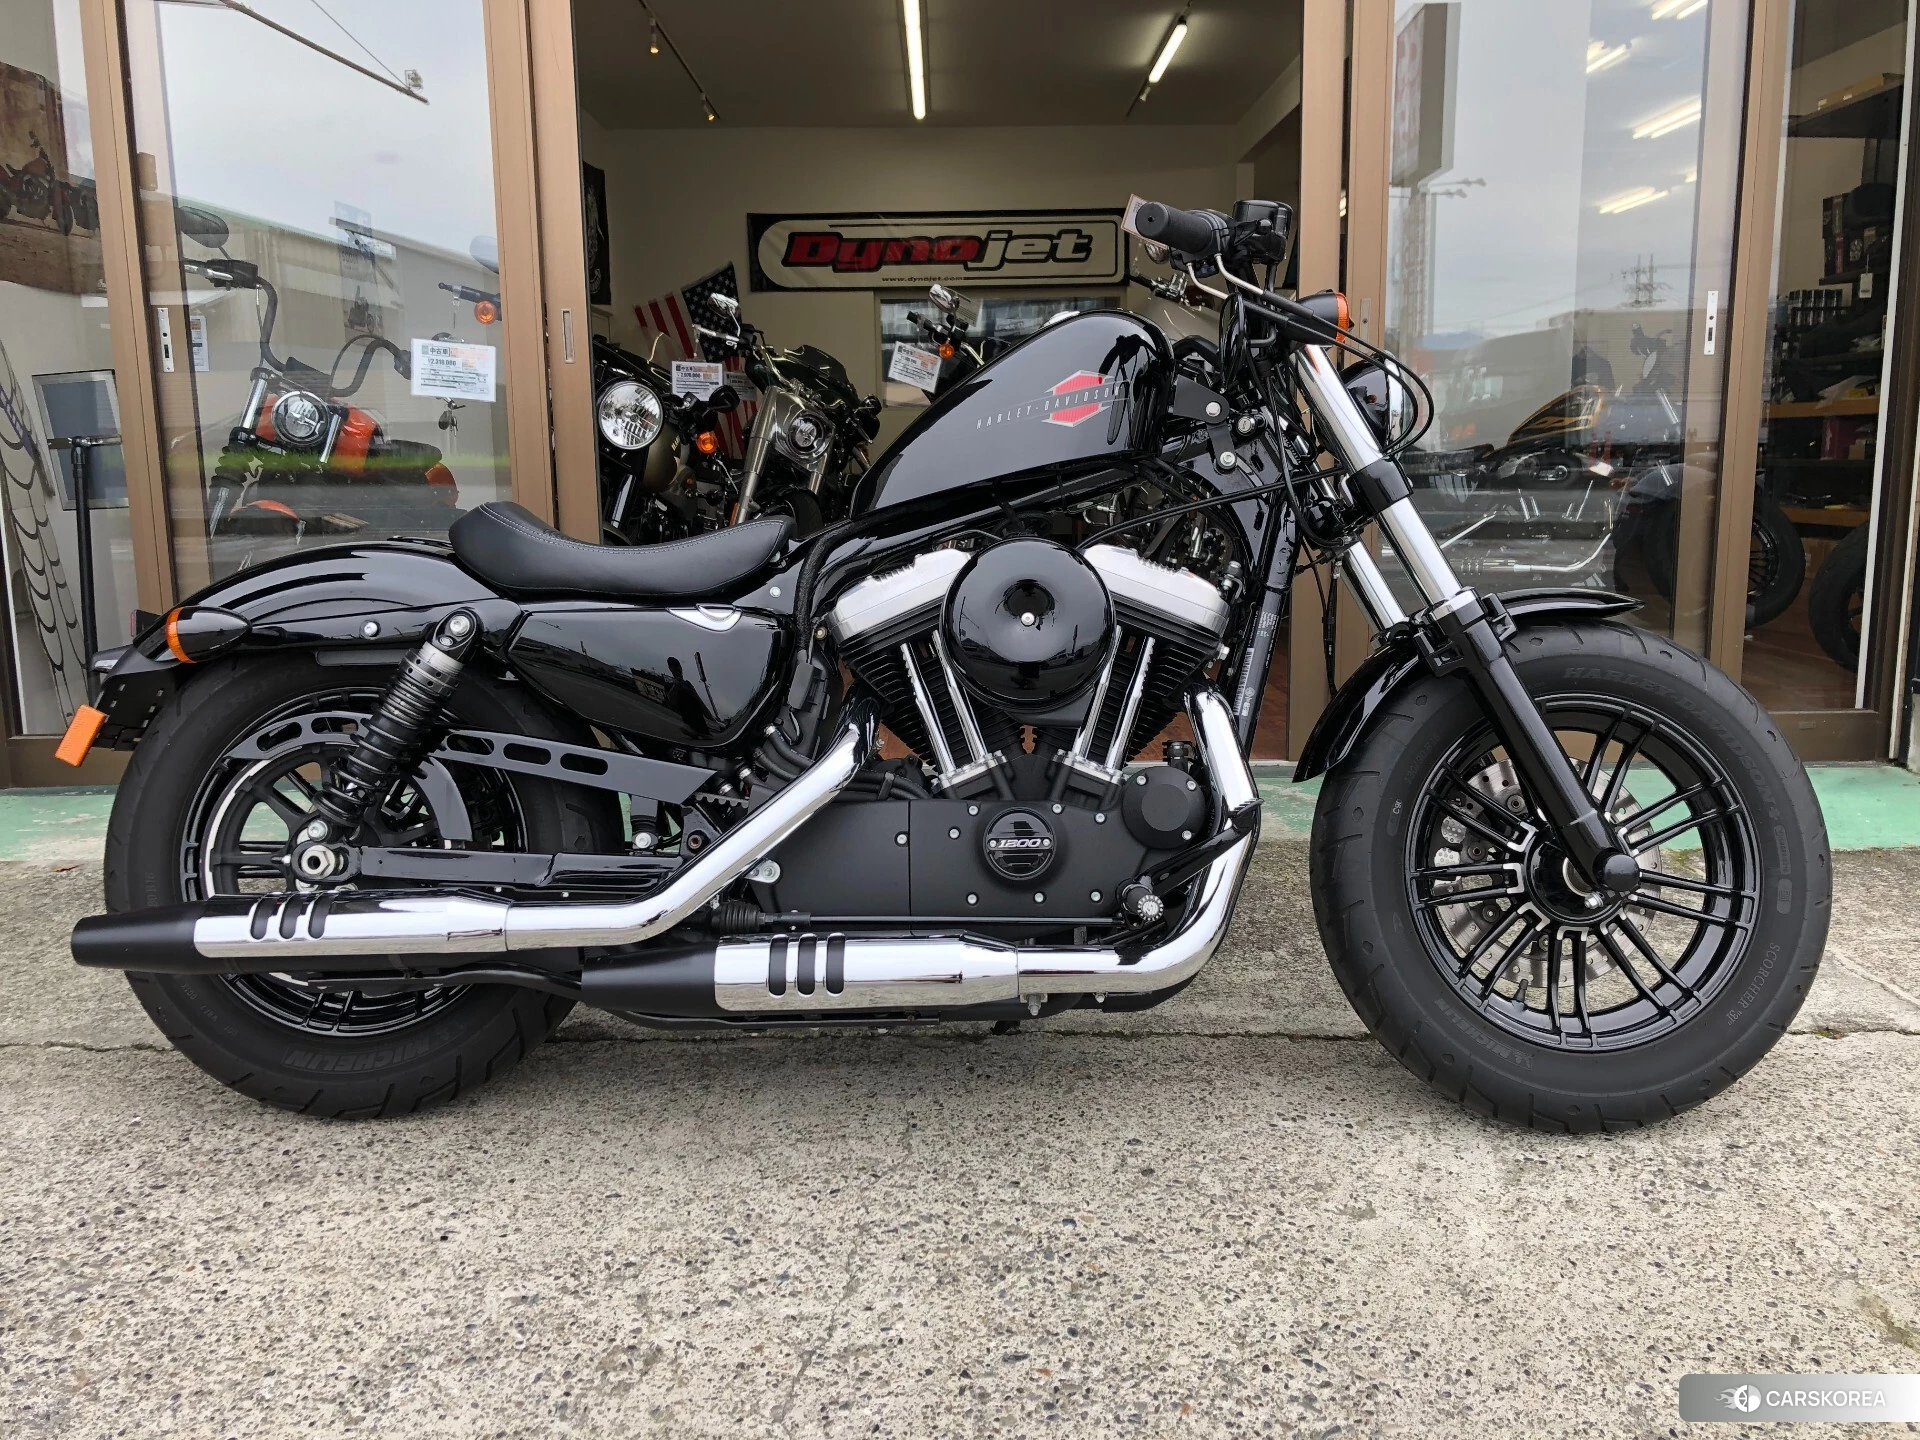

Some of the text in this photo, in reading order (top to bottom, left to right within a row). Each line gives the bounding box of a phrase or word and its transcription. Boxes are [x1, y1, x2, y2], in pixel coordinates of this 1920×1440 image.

[783, 229, 1093, 272] Dynojet
[881, 275, 965, 283] www.dynojet.com
[976, 385, 1121, 430] HARLEY-DAVIDSON
[998, 838, 1042, 849] 1200
[1737, 942, 1781, 1009] SCORCHER
[283, 1037, 431, 1072] MICHELIN
